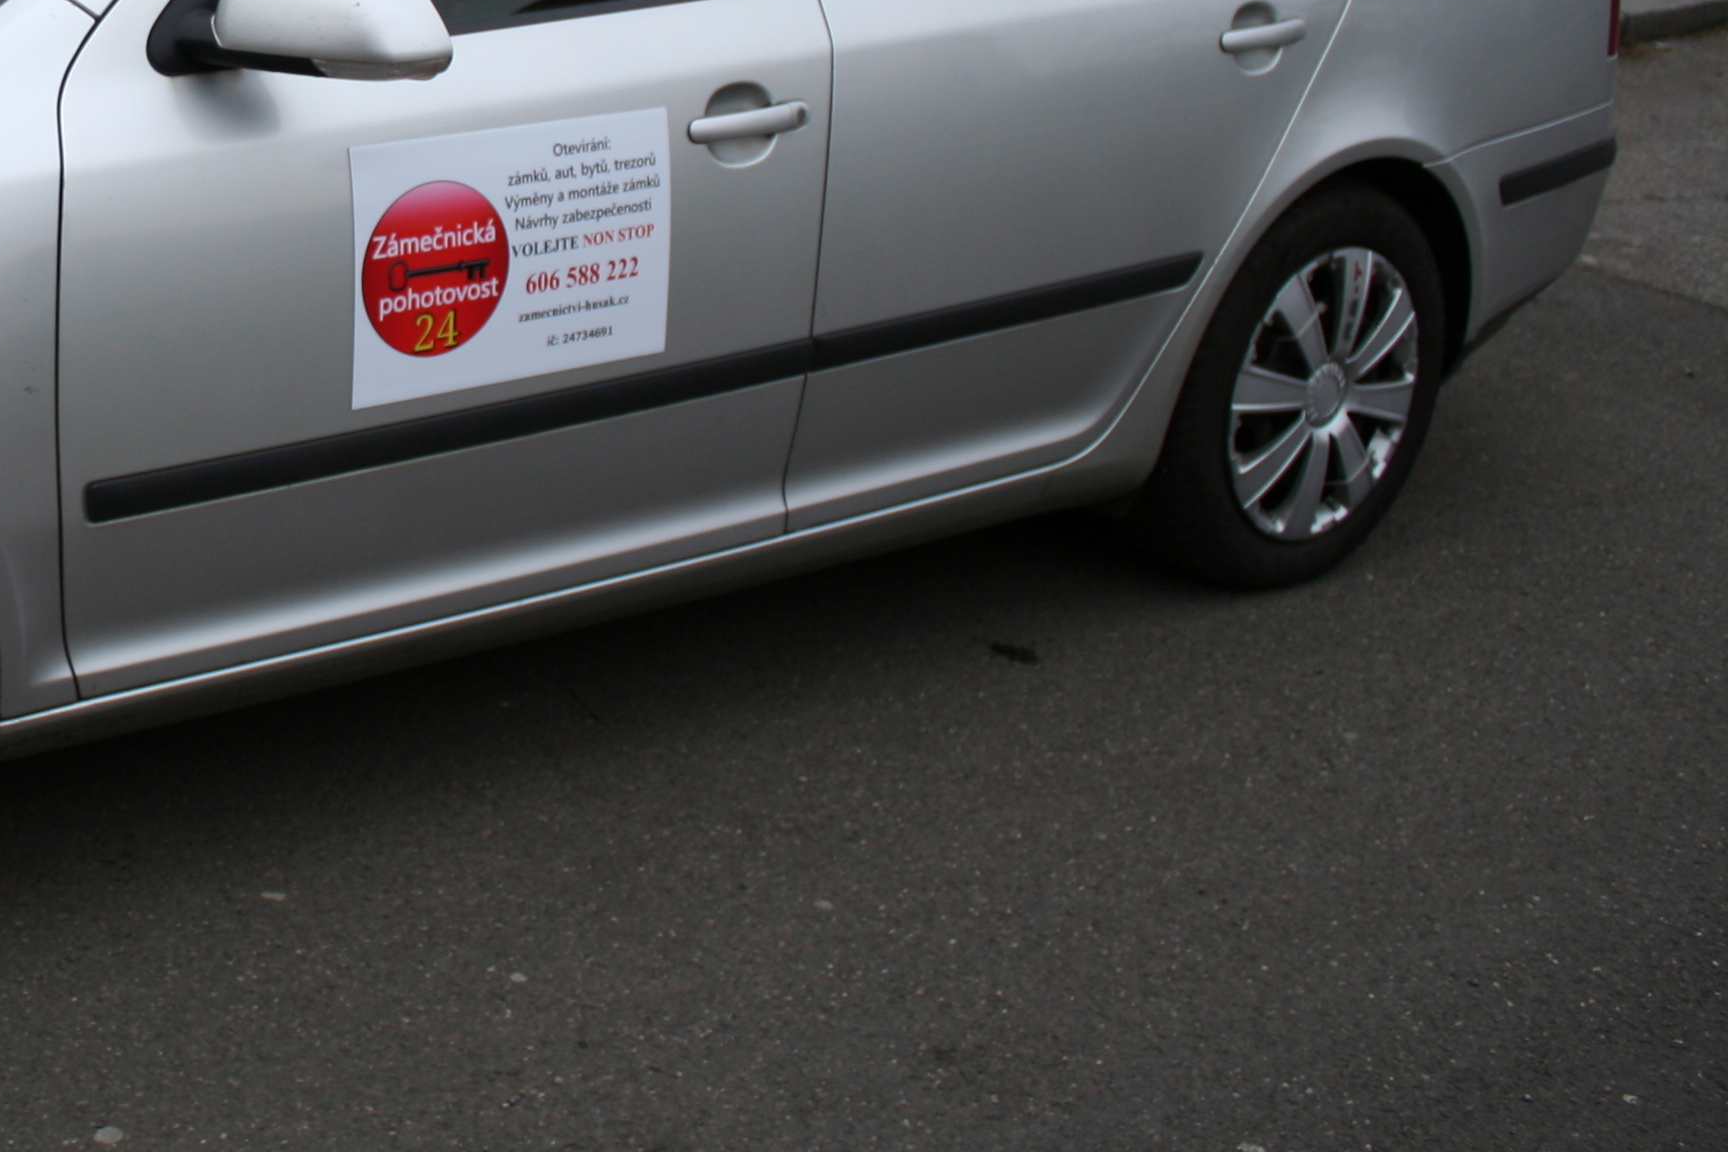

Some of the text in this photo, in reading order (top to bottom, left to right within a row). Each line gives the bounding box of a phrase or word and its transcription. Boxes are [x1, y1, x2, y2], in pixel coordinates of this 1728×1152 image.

[508, 167, 551, 186] zámků,
[581, 159, 611, 179] bytů,
[615, 152, 657, 171] trezorů
[505, 174, 661, 212] Výměny a montáže zámků
[372, 219, 497, 260] Zámečnická
[512, 223, 655, 258] VOLEJTE NON STOP
[515, 214, 559, 231] Návrhy
[526, 256, 639, 295] 606 588 222
[379, 278, 500, 321] pohotovost
[412, 308, 459, 353] 24
